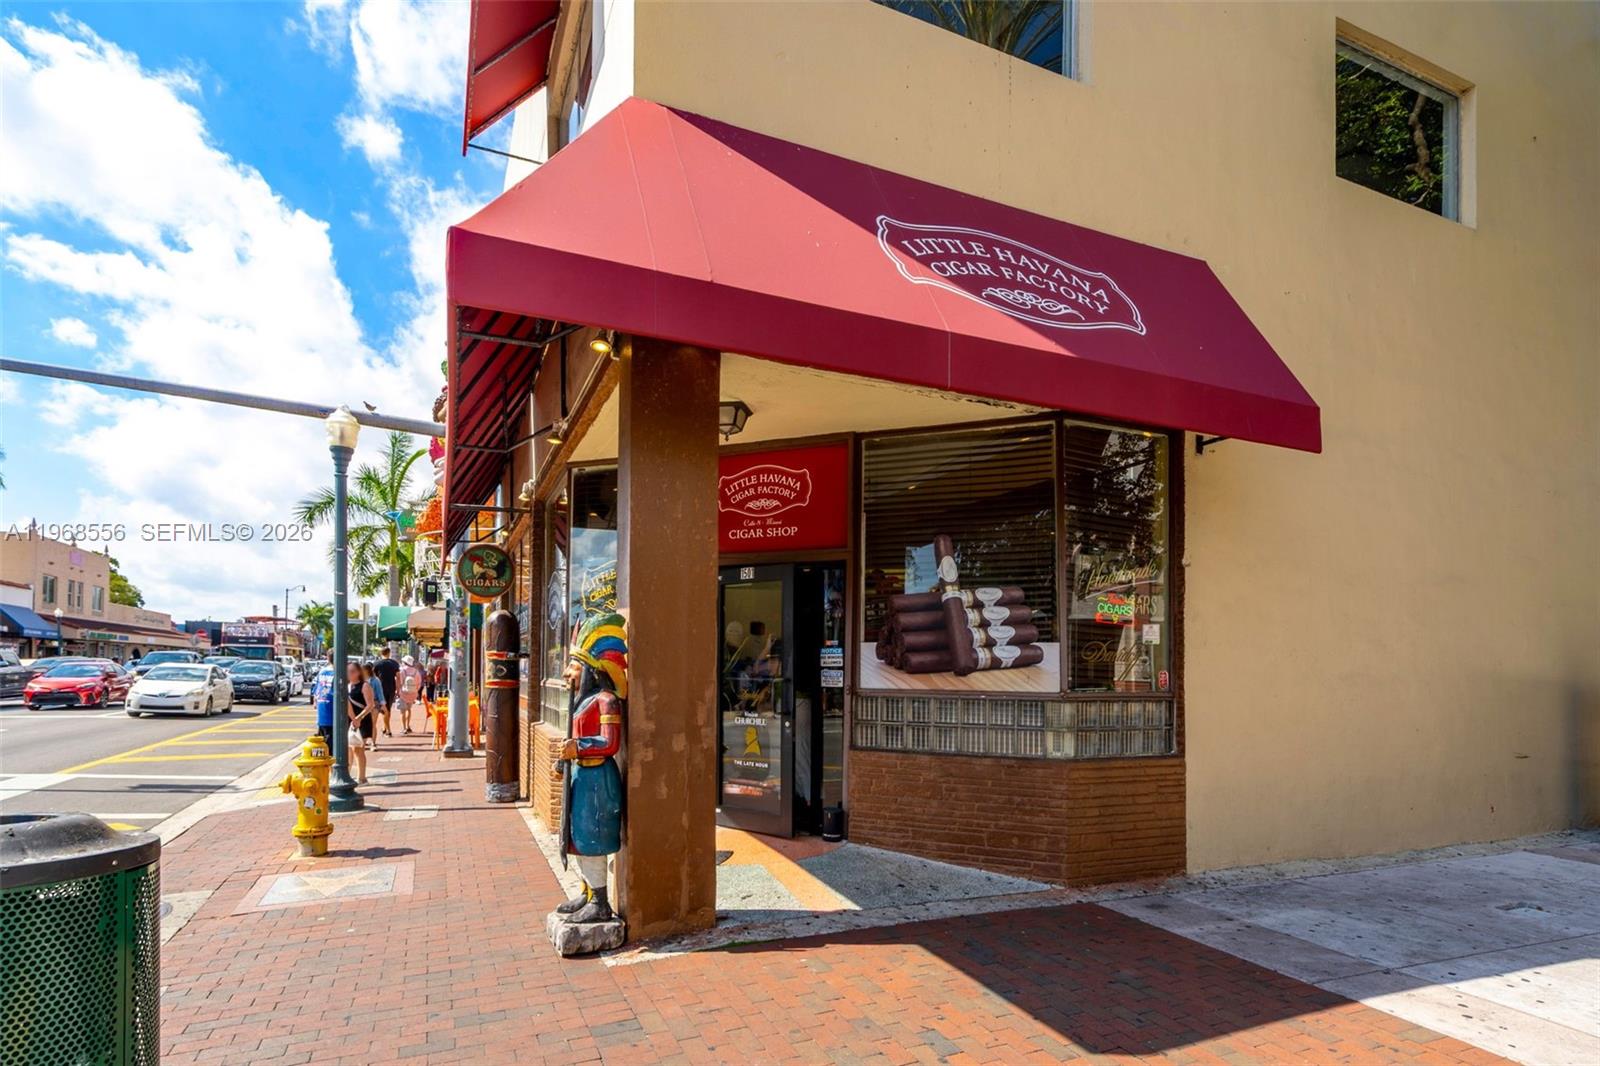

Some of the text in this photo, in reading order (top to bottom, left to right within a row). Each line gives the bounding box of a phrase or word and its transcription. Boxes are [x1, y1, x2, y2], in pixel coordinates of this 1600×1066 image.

[901, 237, 1111, 304] LITTLE HAVANA
[930, 260, 1110, 314] CIGAR FACTORY
[725, 473, 801, 496] LITTLE HAVANA
[730, 485, 797, 504] CIGAR FACTORY
[728, 526, 798, 540] CIGAR SHOP
[465, 578, 507, 588] CIGARS
[1097, 602, 1133, 617] CIGARS
